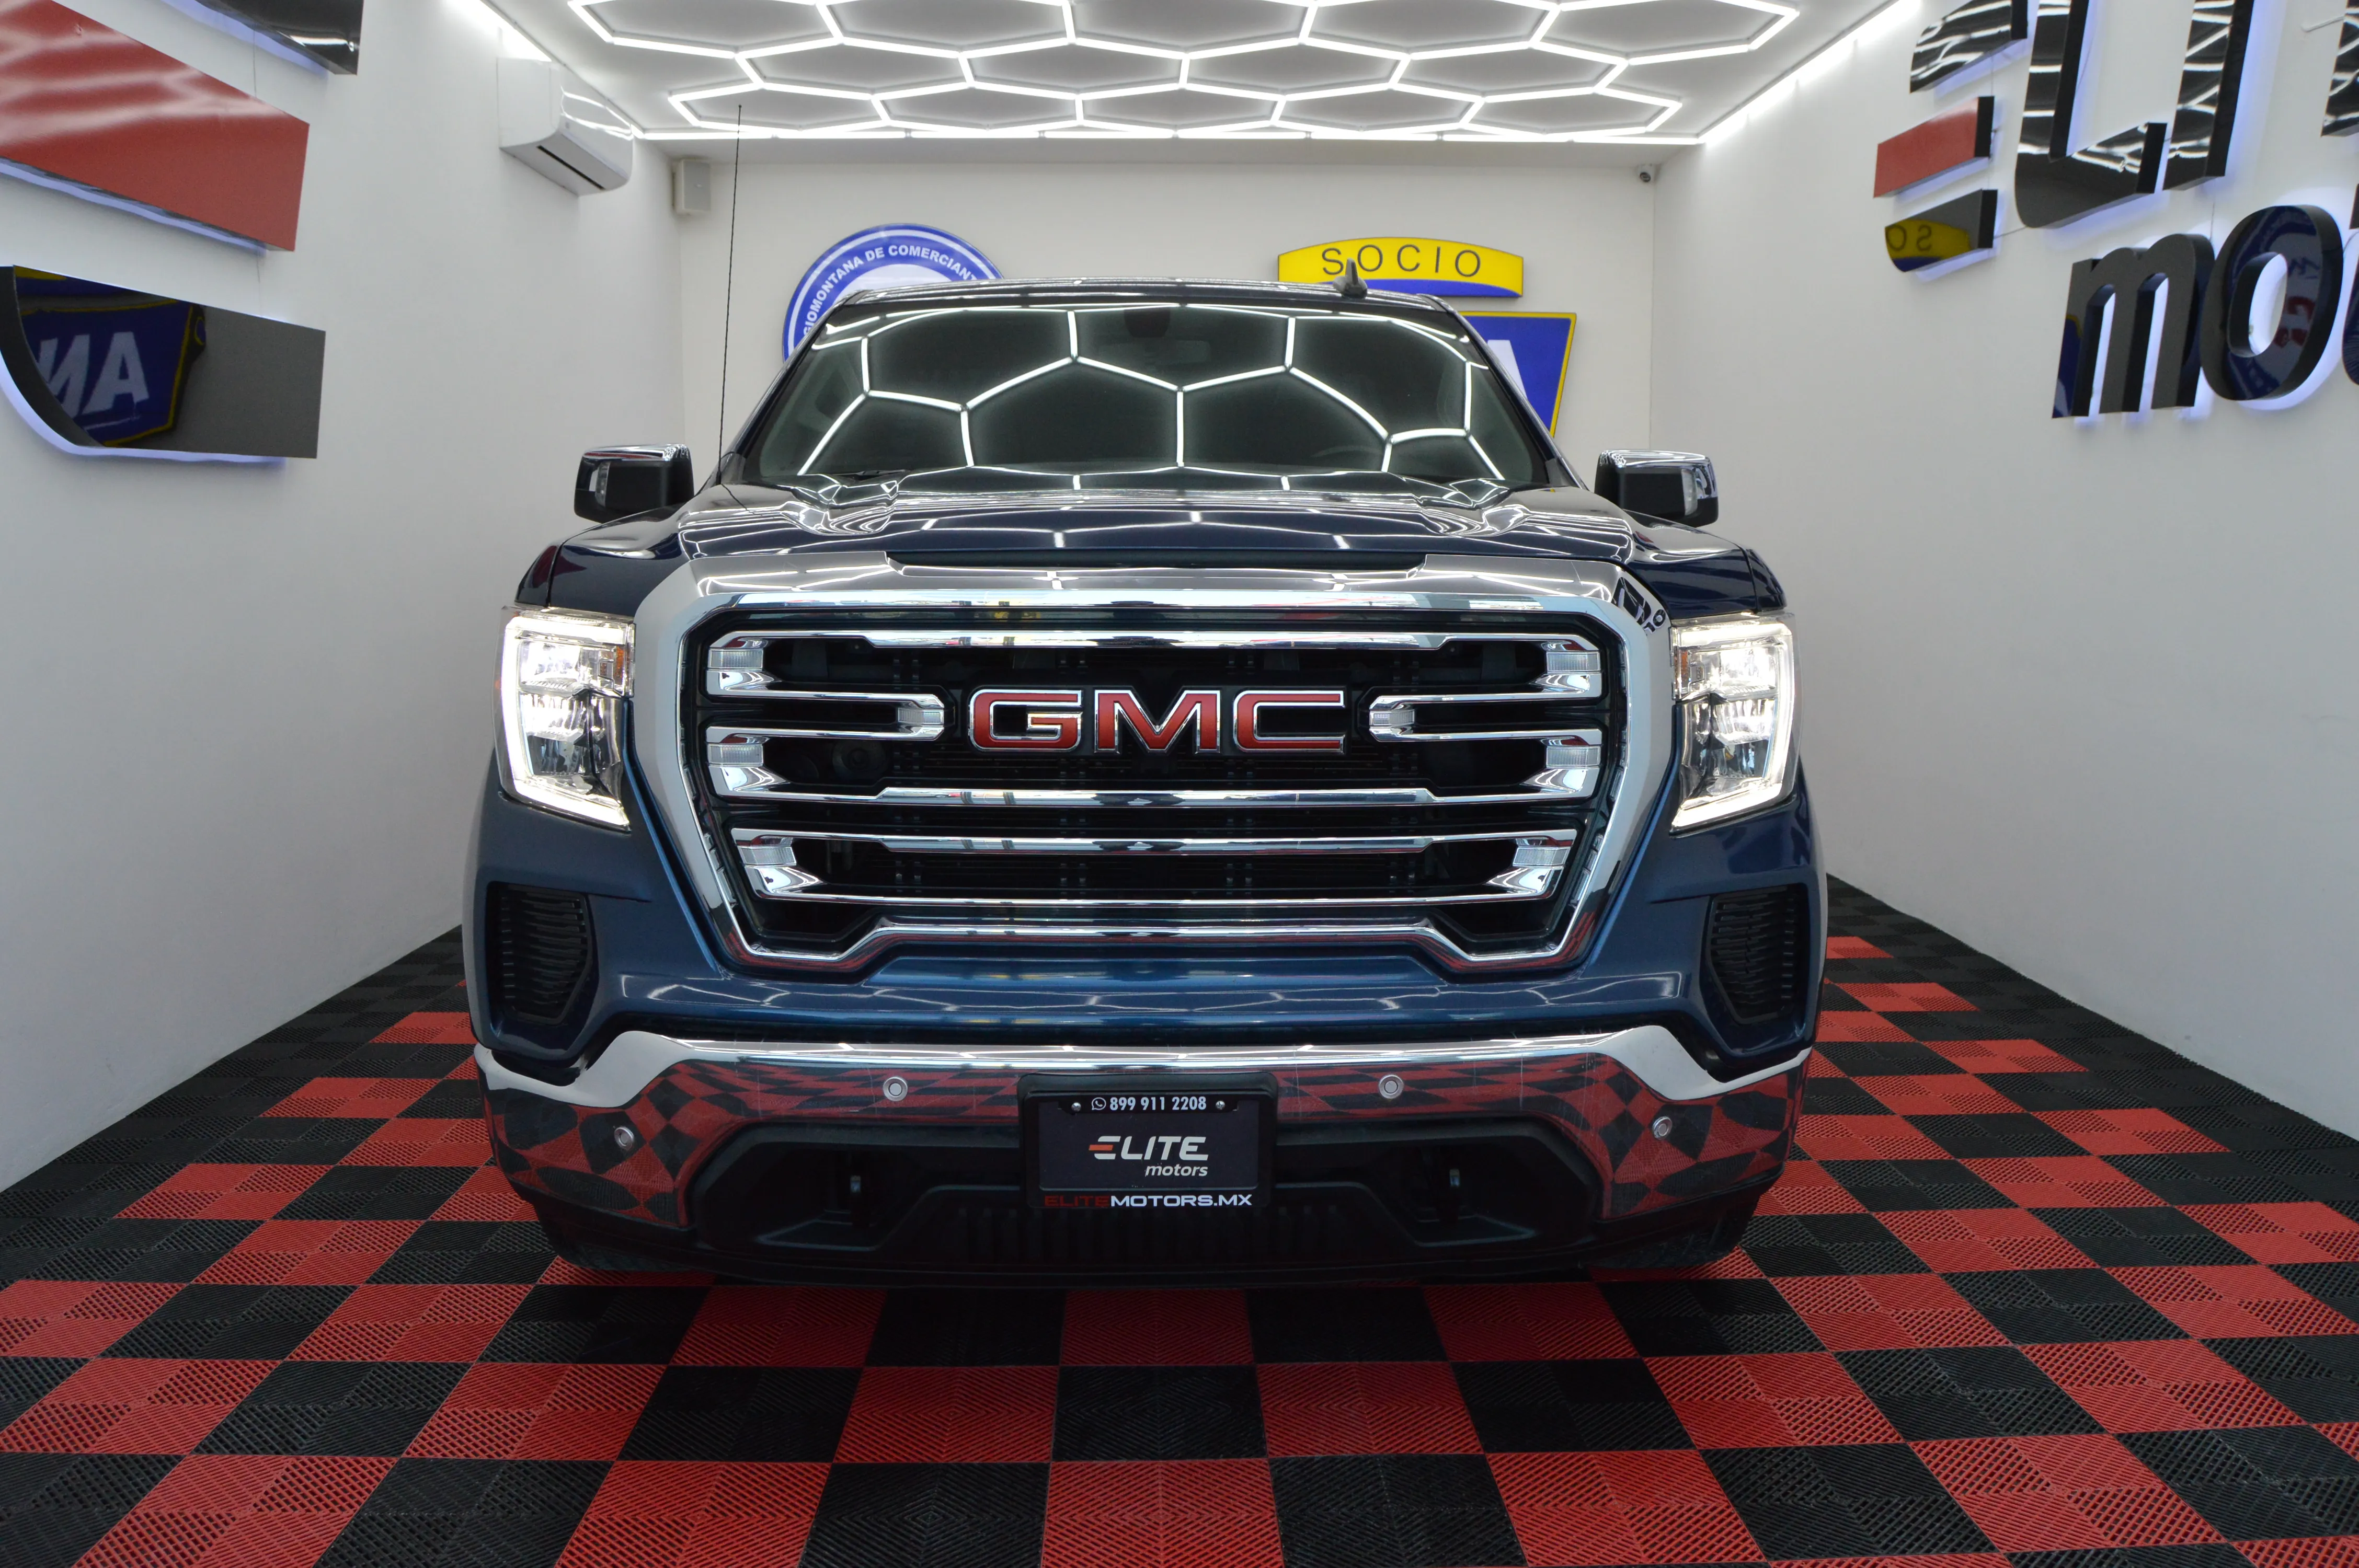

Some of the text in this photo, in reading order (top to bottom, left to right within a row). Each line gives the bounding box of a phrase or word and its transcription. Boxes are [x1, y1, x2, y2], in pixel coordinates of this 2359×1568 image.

[865, 247, 885, 262] DE
[1321, 244, 1482, 277] SOCIO
[968, 688, 1346, 754] GMC
[1109, 1096, 1207, 1111] 899 911 2208
[1089, 1136, 1209, 1160] ELITE
[1145, 1163, 1208, 1177] motors
[1044, 1194, 1253, 1207] ELITEMOTORS.MX
